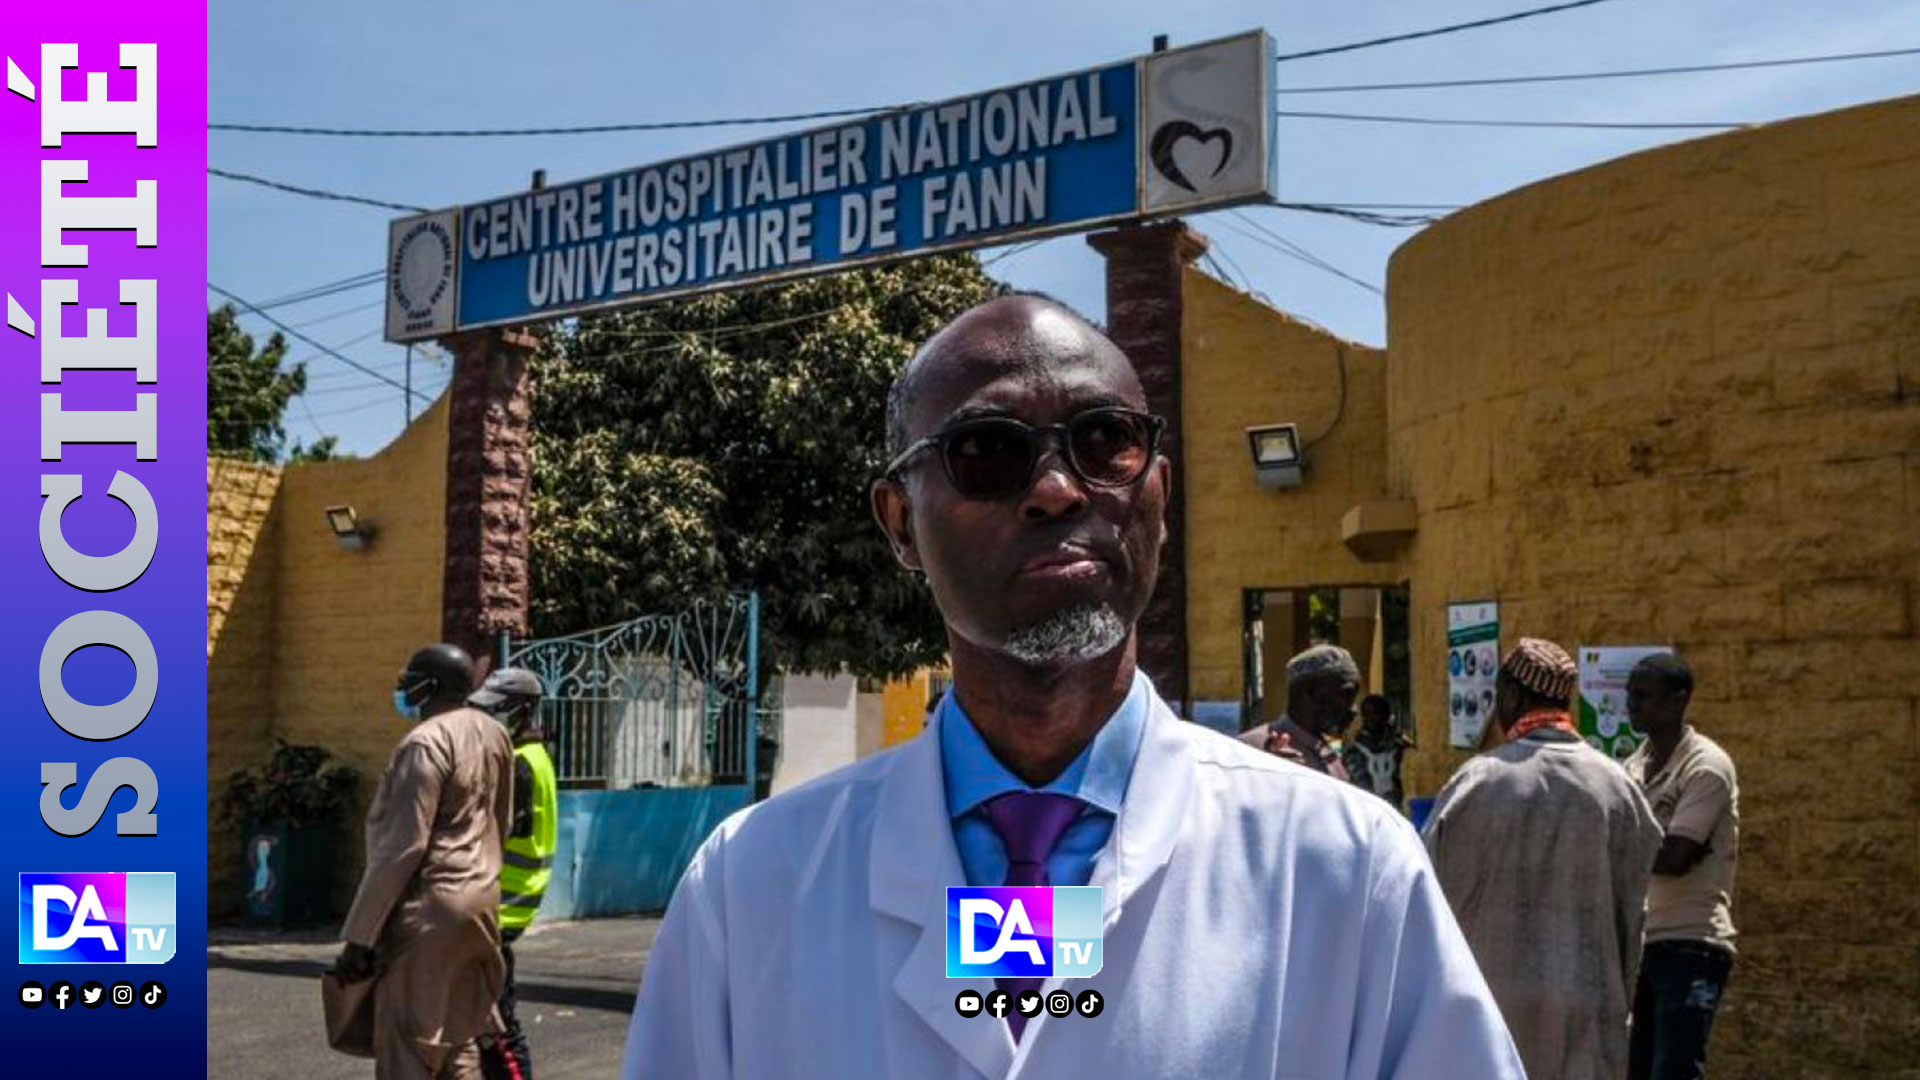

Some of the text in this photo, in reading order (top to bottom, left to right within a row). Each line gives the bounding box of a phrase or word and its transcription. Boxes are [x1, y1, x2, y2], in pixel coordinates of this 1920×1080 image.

[466, 74, 1117, 260] CENTRE HOSPITALIER NATIONAL
[528, 204, 812, 307] UNIVERSITAIRE
[840, 185, 897, 255] DE
[923, 157, 1046, 239] FANN
